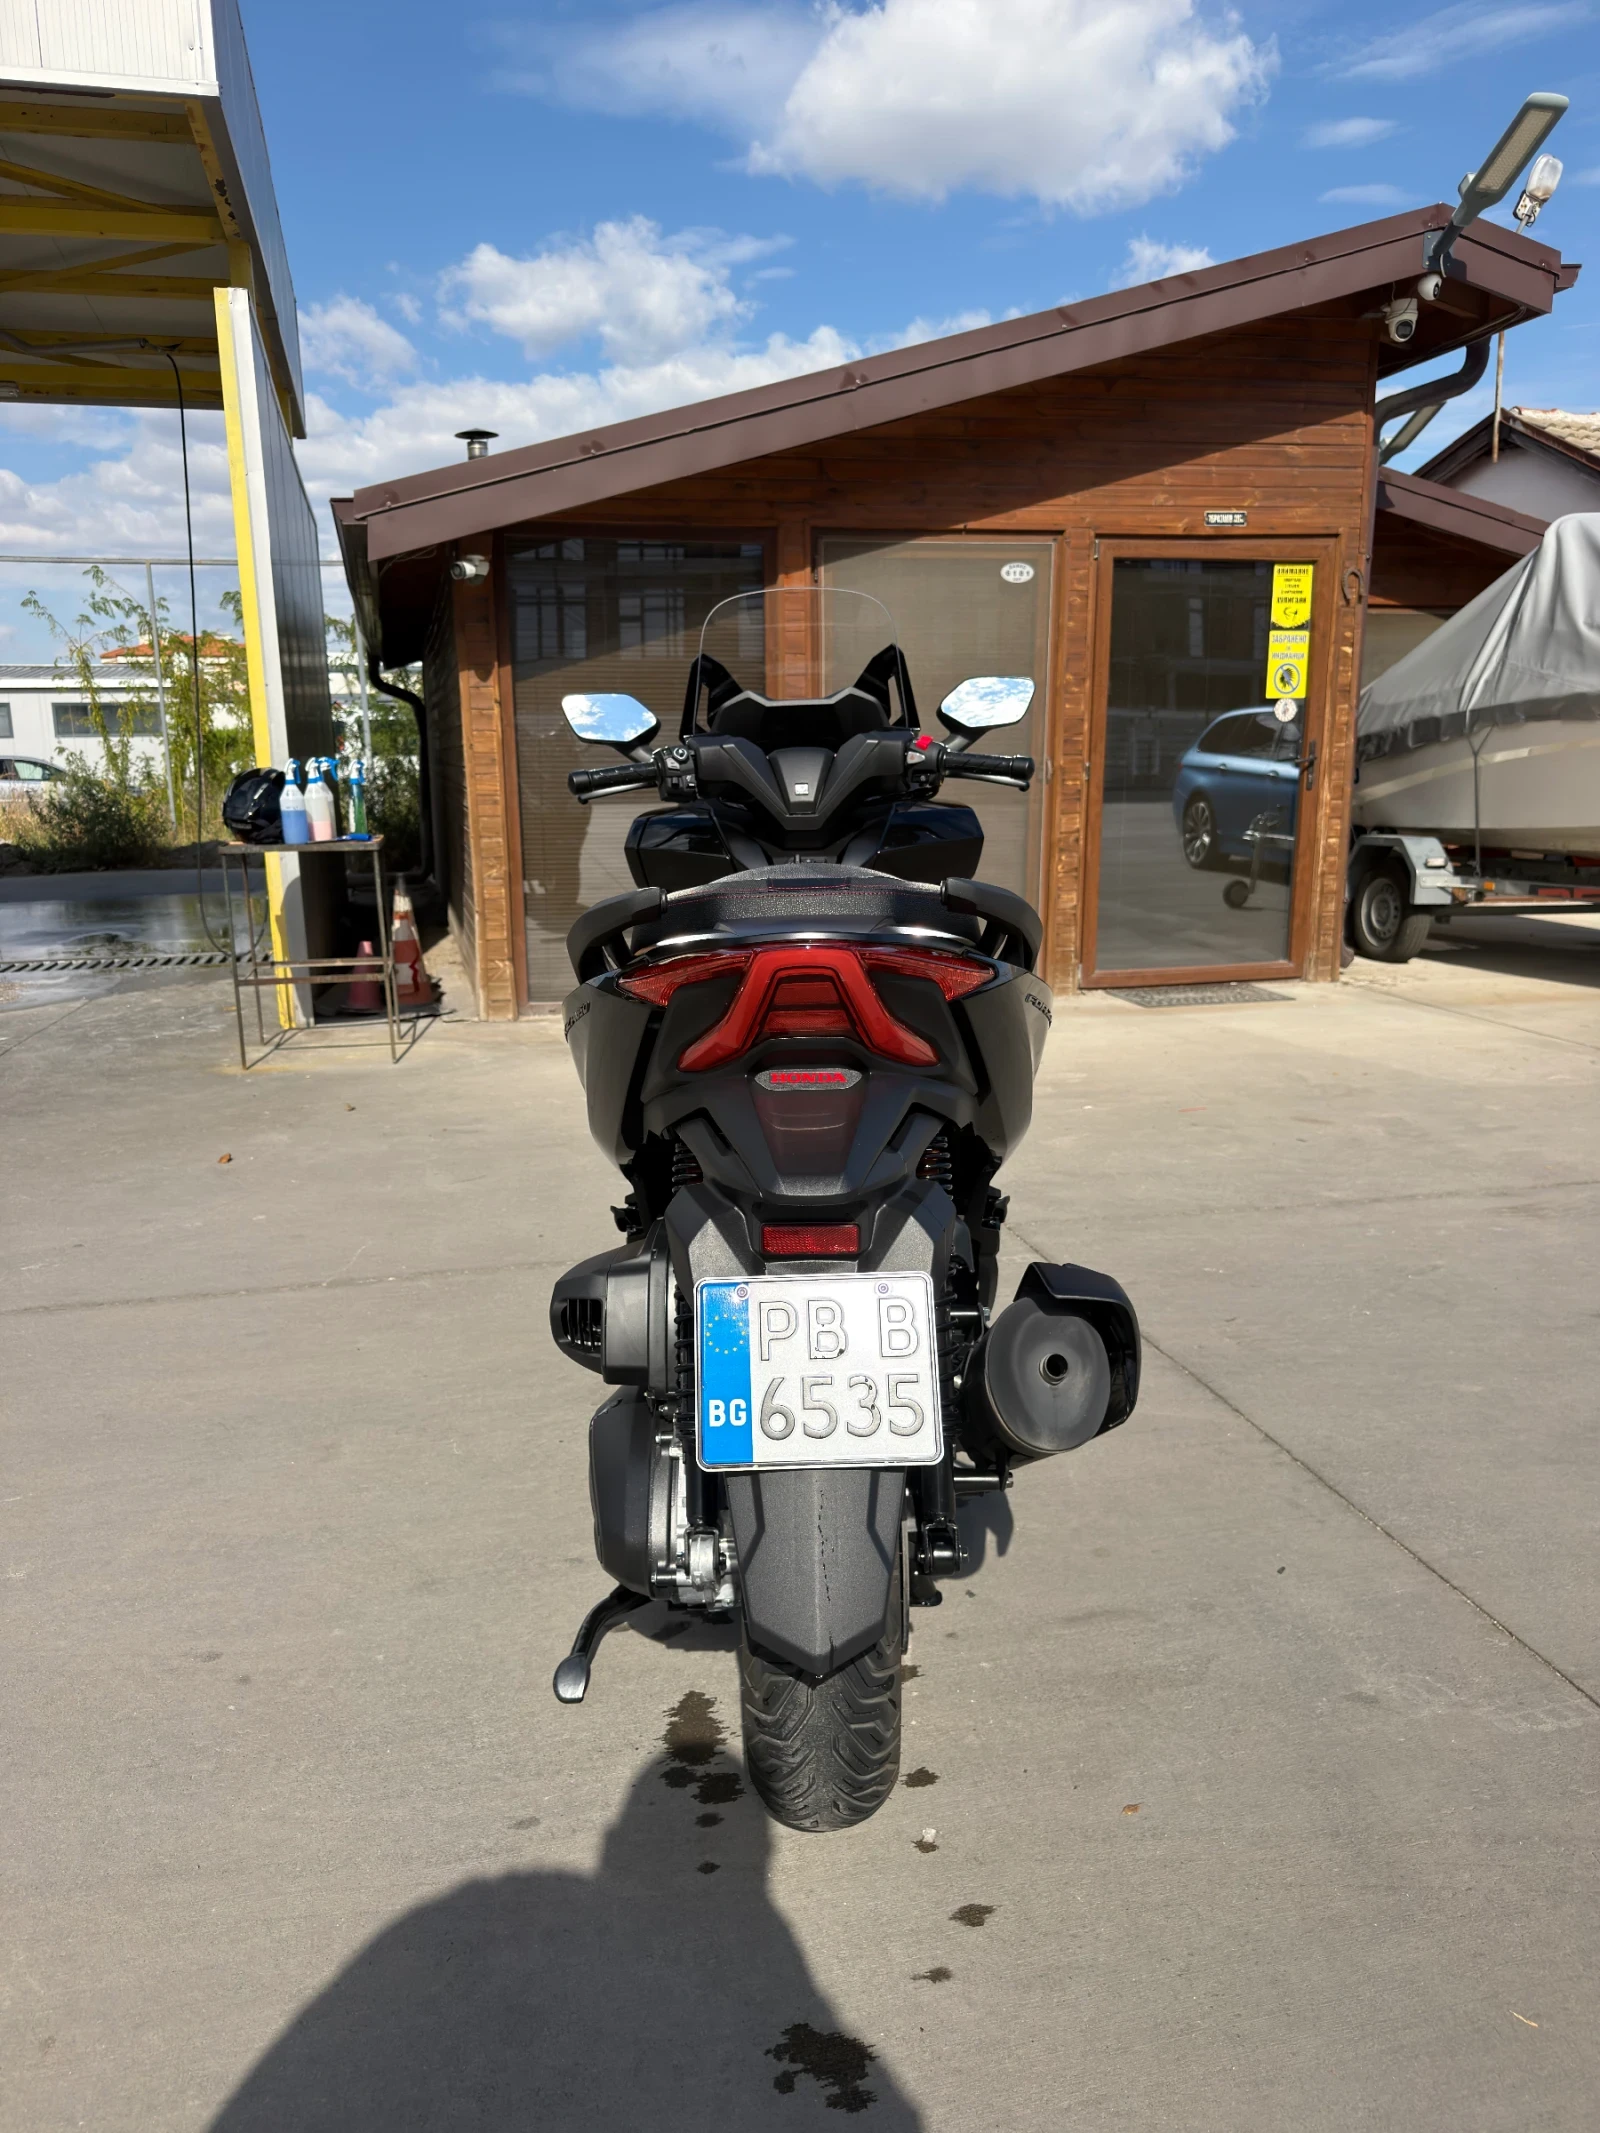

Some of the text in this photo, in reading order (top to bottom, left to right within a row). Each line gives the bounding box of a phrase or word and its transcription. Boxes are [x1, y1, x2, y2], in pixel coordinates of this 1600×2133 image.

[769, 1071, 848, 1084] HONDA
[759, 1297, 920, 1362] PB B
[708, 1398, 747, 1428] BG
[759, 1373, 926, 1442] 6535
